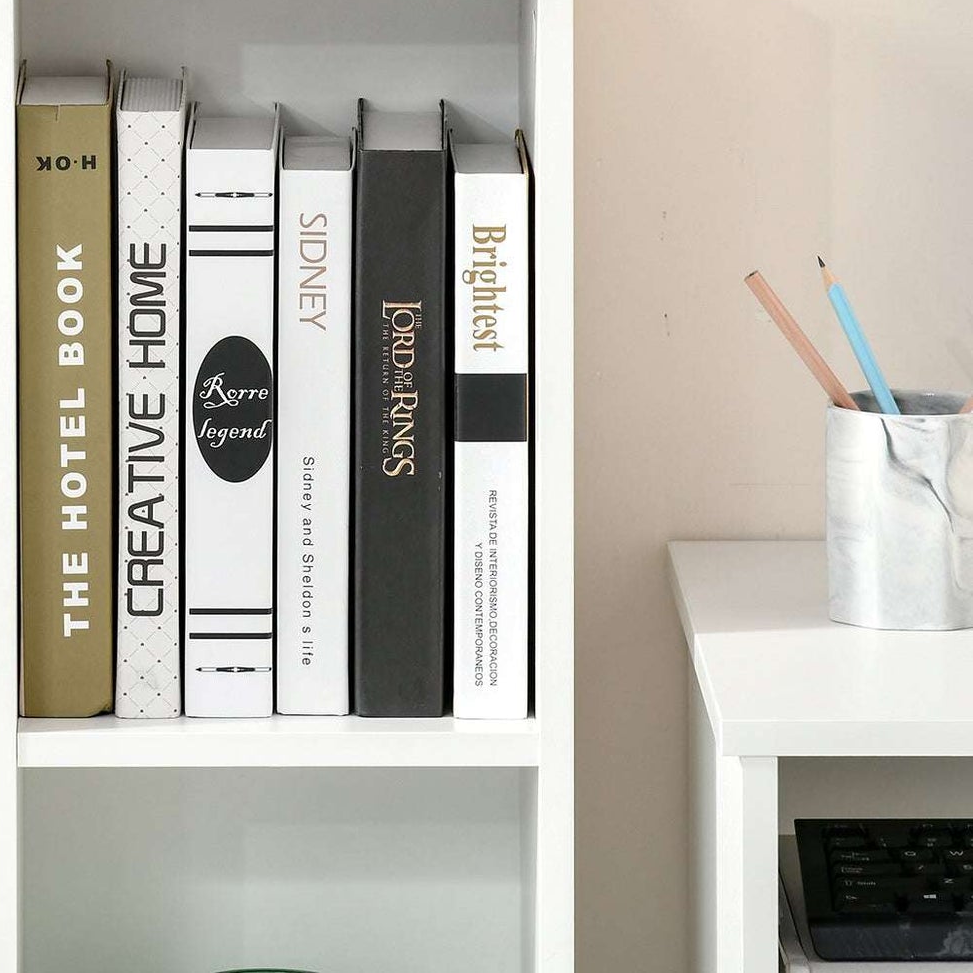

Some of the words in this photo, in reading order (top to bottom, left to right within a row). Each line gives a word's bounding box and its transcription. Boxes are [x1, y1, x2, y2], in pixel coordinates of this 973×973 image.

[56, 243, 85, 366] BOOK
[299, 213, 327, 331] SIDNEY
[462, 224, 507, 351] Brightest
[129, 243, 166, 369] HOME
[382, 300, 422, 369] LORD
[199, 372, 268, 408] Rorre
[394, 368, 404, 391] THE
[403, 371, 414, 388] OF
[60, 387, 88, 530] HOTEL
[198, 418, 272, 448] legend
[382, 390, 418, 477] RINGS
[127, 393, 166, 617] CREATIVE
[301, 456, 314, 511] Sidney
[488, 489, 497, 530] REVISTA
[302, 517, 314, 546] and
[488, 531, 497, 545] DE
[62, 552, 89, 638] THE
[302, 553, 314, 618] Sheldon
[302, 626, 311, 634] s
[302, 640, 314, 666] life
[474, 590, 483, 687] CONTEMPORANEOS
